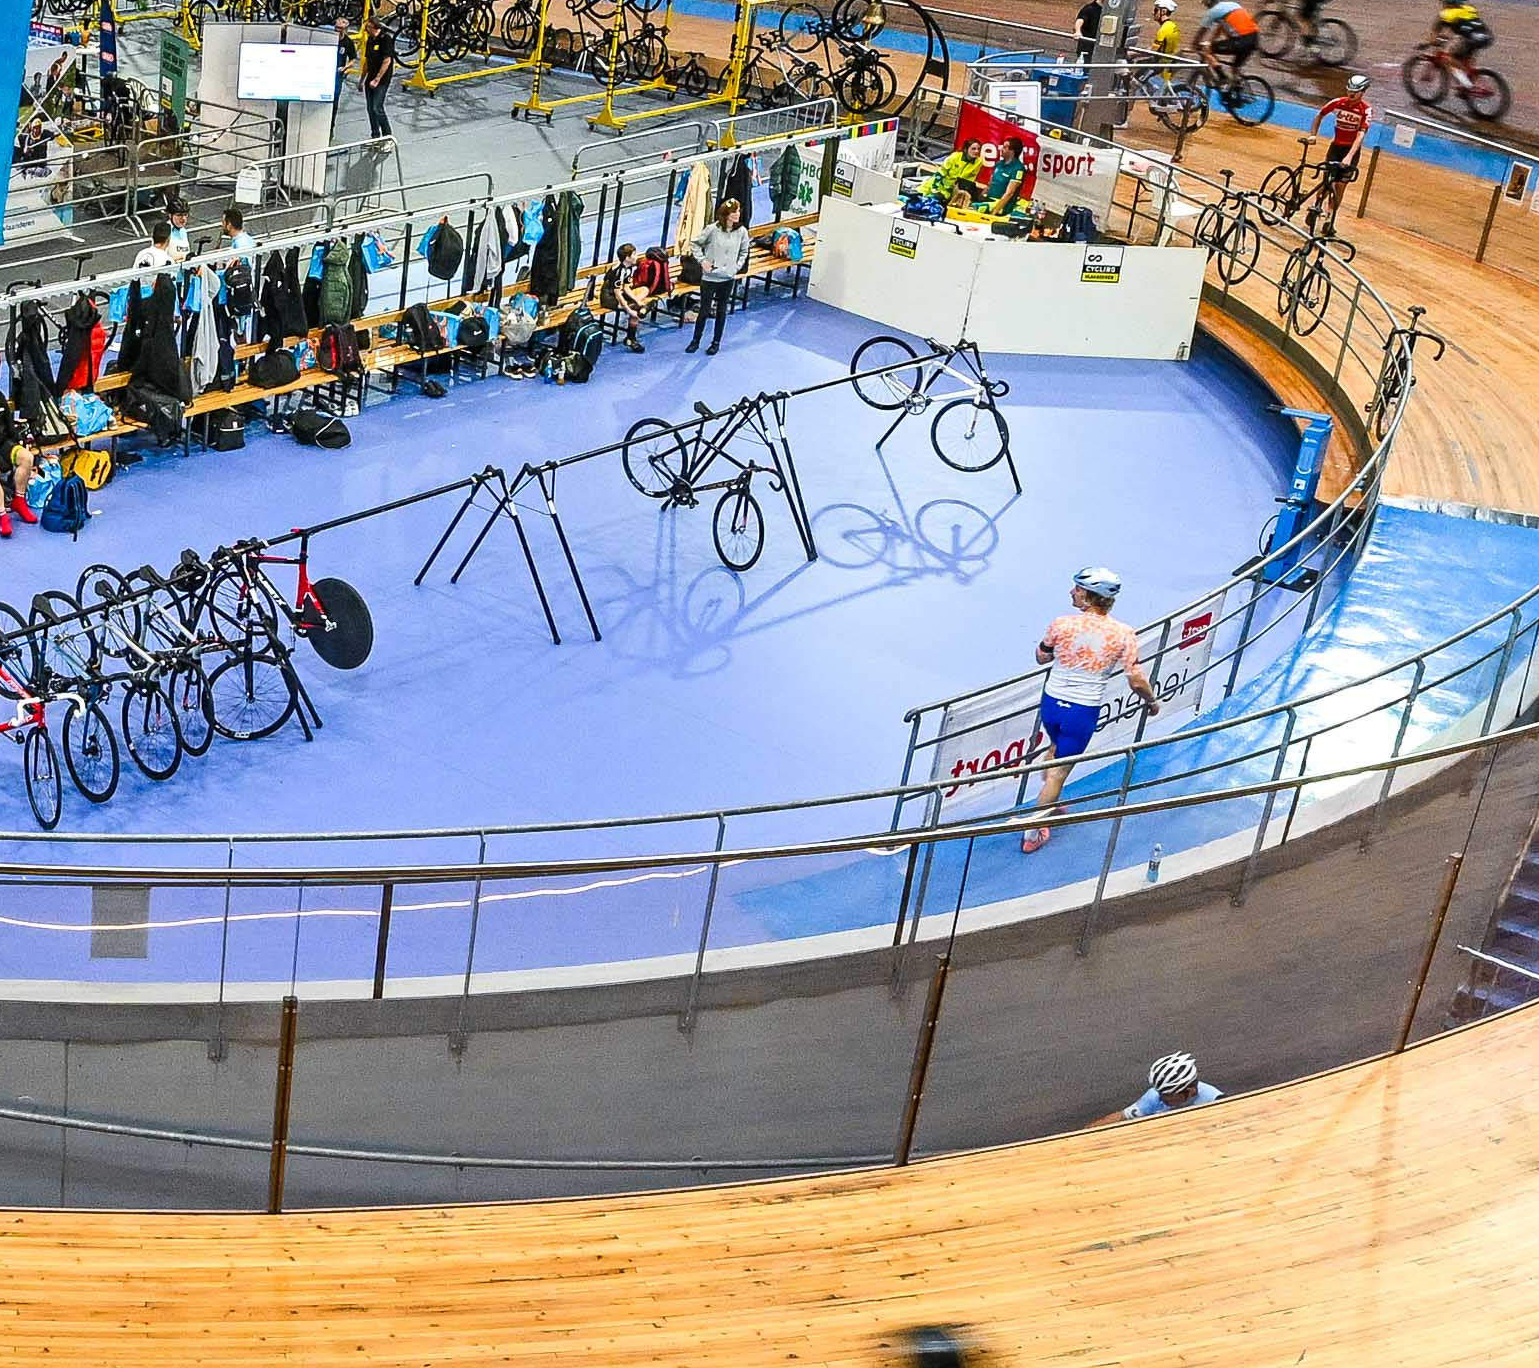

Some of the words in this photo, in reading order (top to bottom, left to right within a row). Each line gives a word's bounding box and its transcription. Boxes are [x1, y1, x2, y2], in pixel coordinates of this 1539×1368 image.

[802, 162, 822, 180] HBO
[1041, 152, 1096, 179] sport
[891, 237, 914, 249] CYCLING
[1085, 265, 1117, 273] CYCLING
